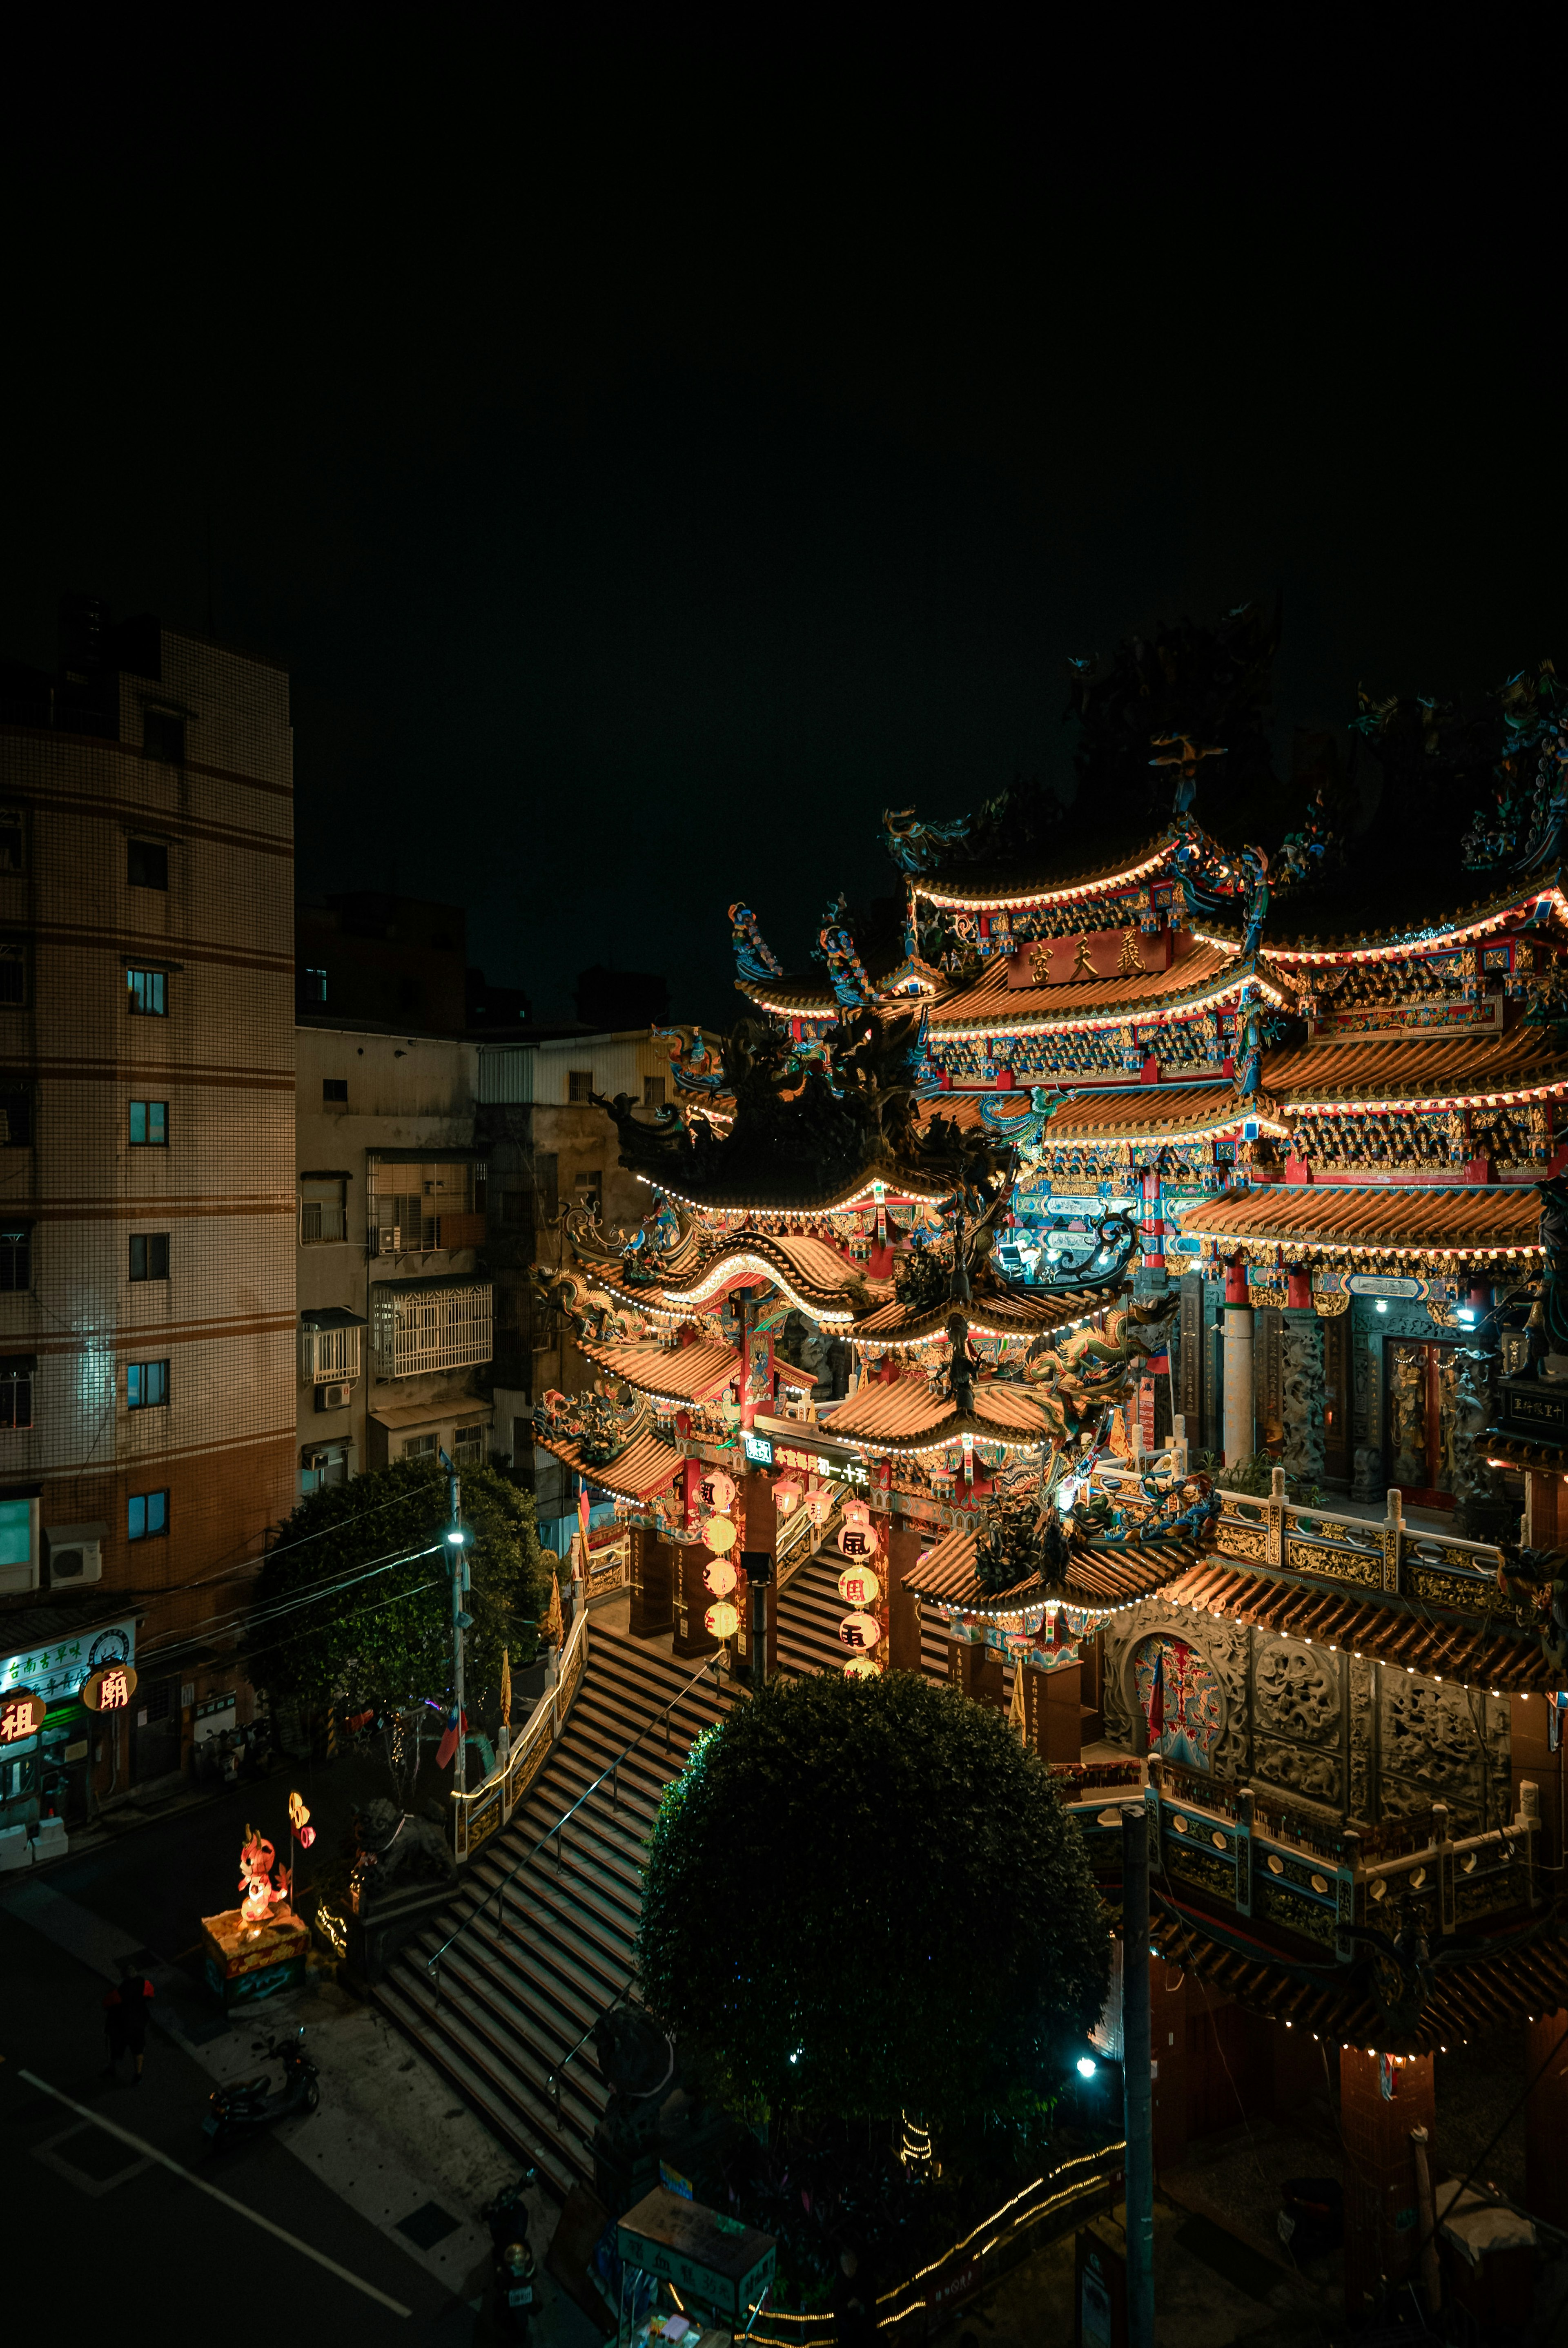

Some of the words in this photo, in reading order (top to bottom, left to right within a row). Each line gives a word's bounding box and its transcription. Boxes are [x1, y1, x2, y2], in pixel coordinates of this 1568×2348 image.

[9, 1641, 82, 1679] 台南古早味
[100, 1670, 129, 1709] 廟
[0, 1702, 38, 1741] 祖
